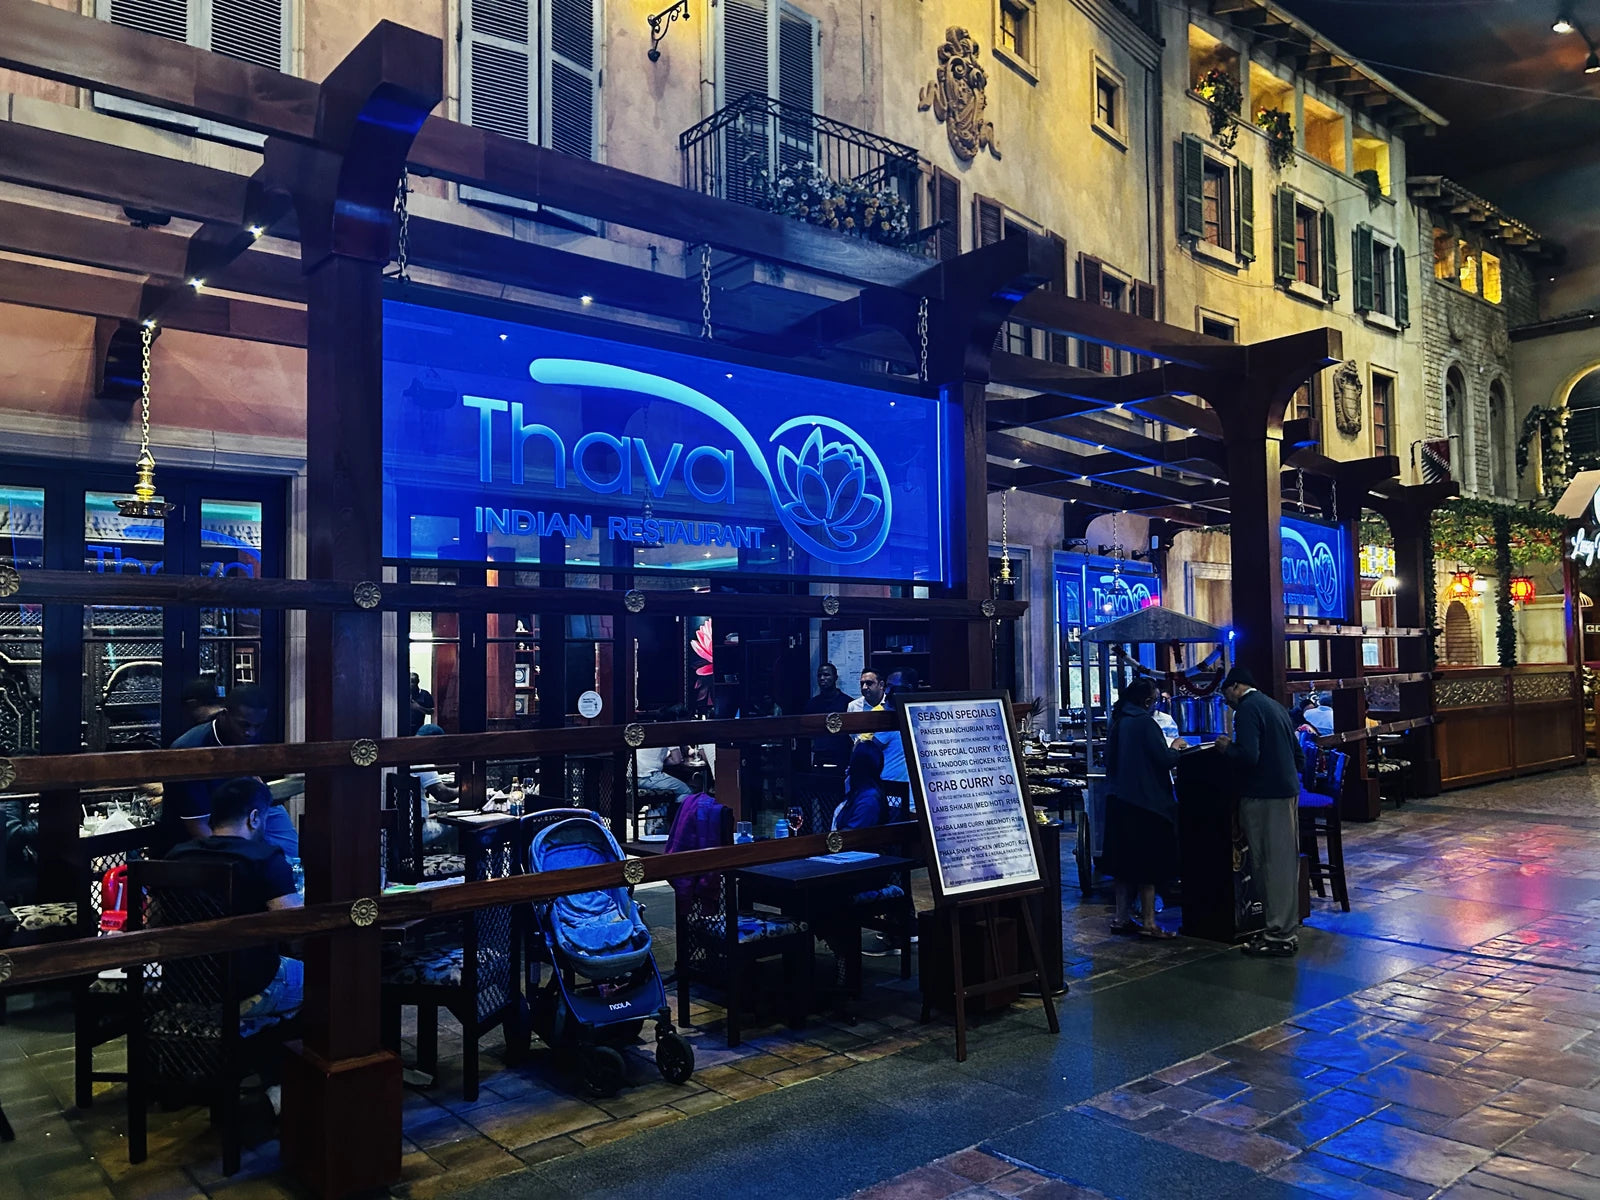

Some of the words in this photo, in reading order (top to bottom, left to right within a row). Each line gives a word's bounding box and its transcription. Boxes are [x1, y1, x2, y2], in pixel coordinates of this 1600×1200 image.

[463, 395, 735, 505] Thava
[475, 506, 591, 540] INDIAN
[608, 516, 764, 549] RESTAURANT
[1282, 556, 1309, 585] ava
[1092, 587, 1128, 611] Thava
[918, 711, 954, 721] SEASON
[956, 708, 996, 719] SPECIALS
[944, 726, 984, 734] MANCHURIAN
[920, 750, 938, 758] SOYA
[939, 748, 967, 756] SPECIAL
[968, 746, 991, 754] CURRY
[994, 744, 1009, 752] R105
[938, 760, 969, 768] TANDOORI
[928, 780, 957, 792] CRAB
[960, 776, 994, 789] CURRY
[999, 774, 1014, 786] SQ
[931, 805, 949, 813] LAMB
[949, 803, 973, 811] SHIKARI
[935, 824, 953, 832] DHABA
[954, 822, 967, 830] LAMB
[971, 845, 992, 853] CHICKEN
